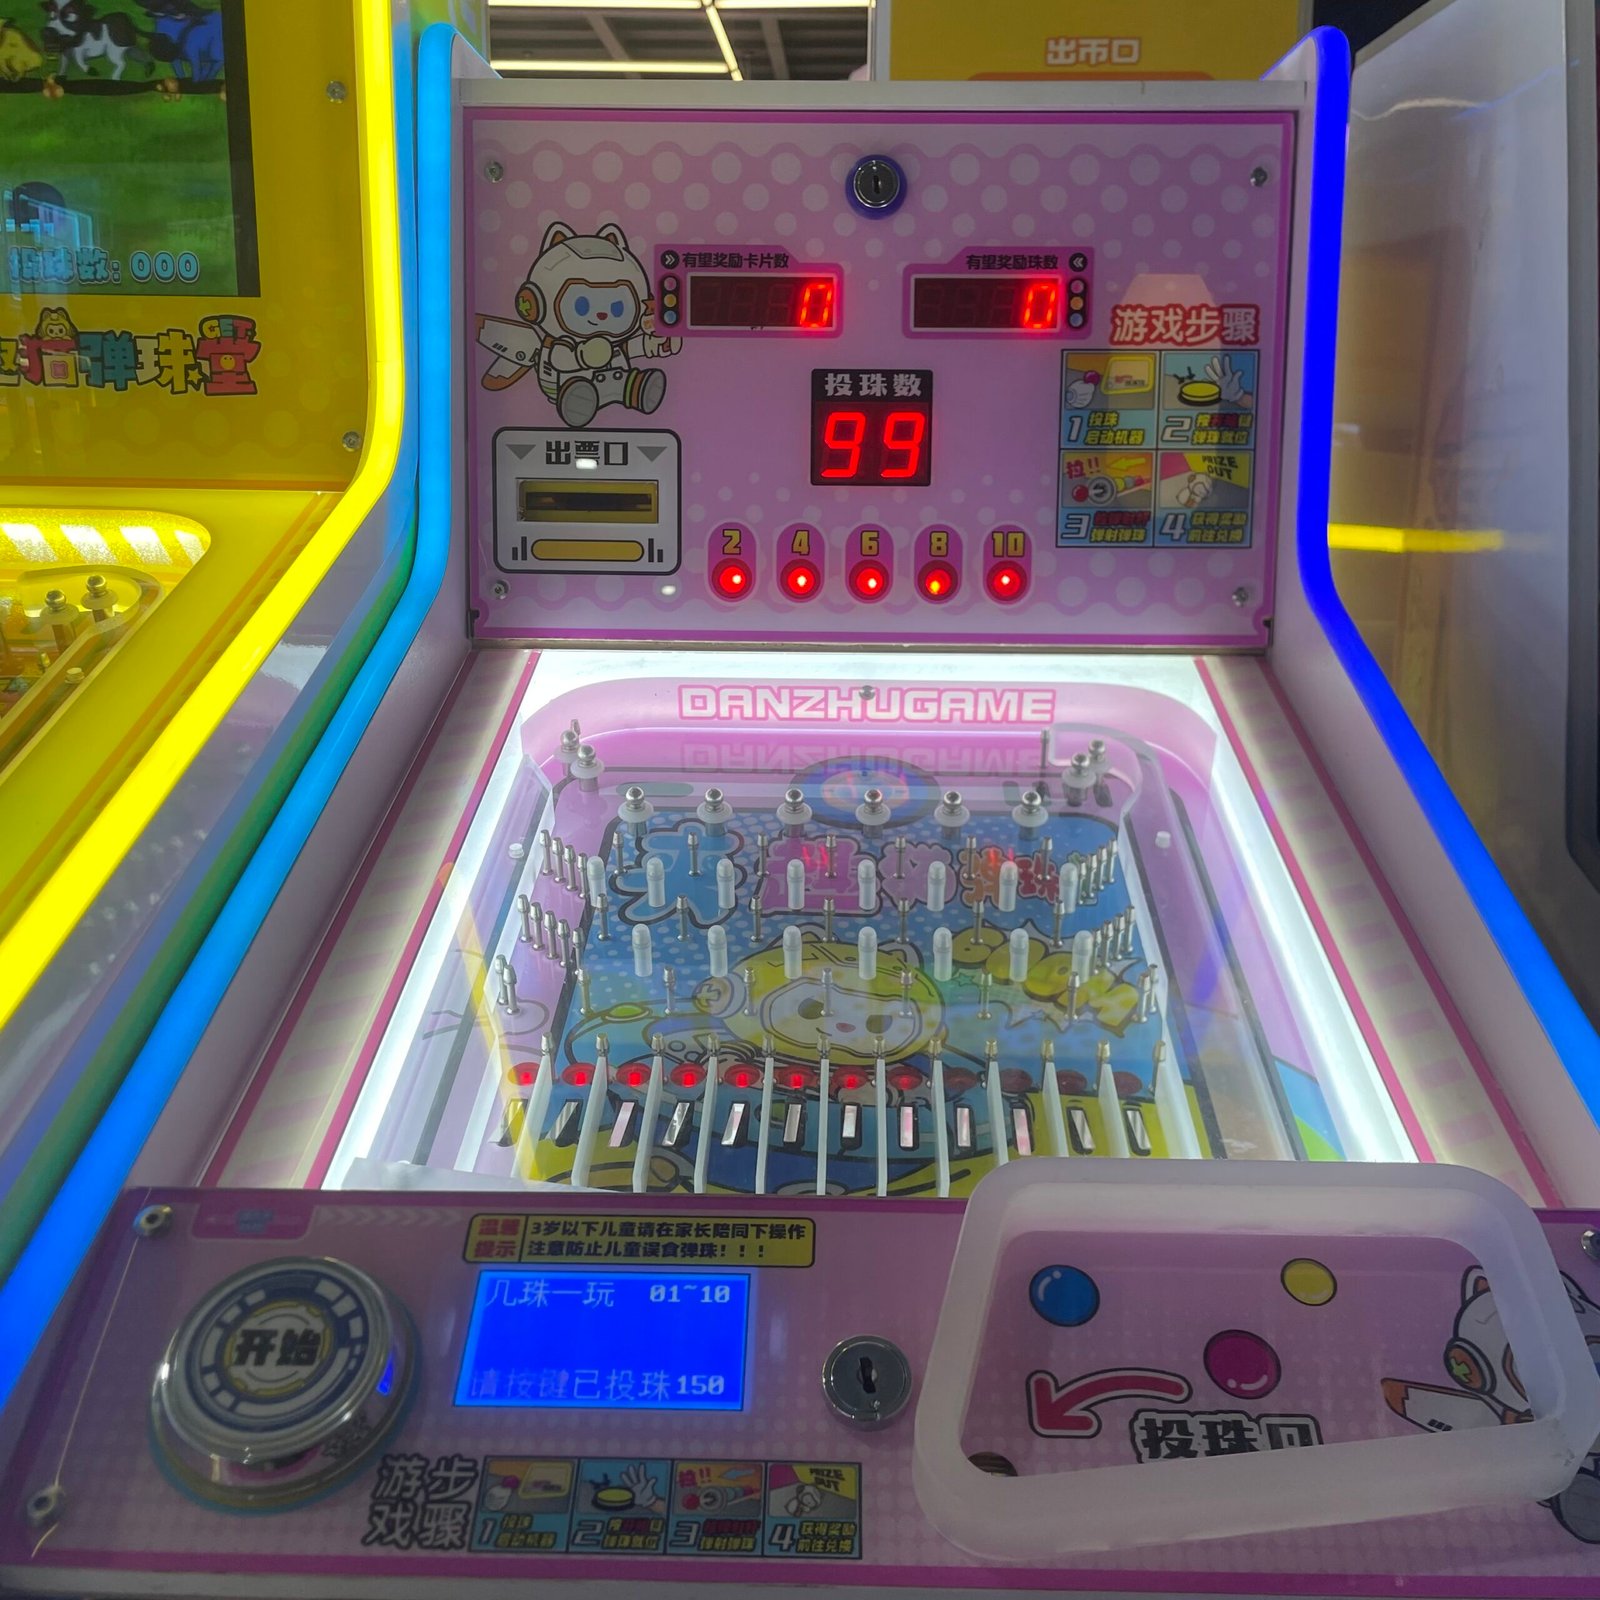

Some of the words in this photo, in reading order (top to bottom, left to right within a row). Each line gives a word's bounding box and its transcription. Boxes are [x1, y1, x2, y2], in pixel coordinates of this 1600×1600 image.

[1046, 38, 1140, 65] 出币口
[130, 251, 199, 283] 000
[682, 252, 789, 269] 有望奖励卡片数
[966, 254, 1058, 270] 有望奖励珠数
[1111, 305, 1258, 344] 游戏步骤
[824, 373, 921, 397] 投珠数
[1162, 416, 1191, 442] 2
[820, 411, 926, 479] 99
[1062, 514, 1090, 539] 3
[1162, 514, 1186, 540] 4
[722, 529, 741, 555] 2
[791, 530, 810, 556] 4
[860, 531, 879, 557] 6
[929, 531, 948, 557] 8
[992, 531, 1025, 557] 10
[679, 685, 1056, 724] DANZHUGAME
[531, 1220, 806, 1240] 3岁以下儿童请在家长陪同下操作
[485, 1278, 615, 1309] 几珠一玩
[234, 1329, 322, 1366] 开始
[573, 1519, 605, 1546] 2
[669, 1519, 701, 1547] 3
[768, 1522, 796, 1552] 4
